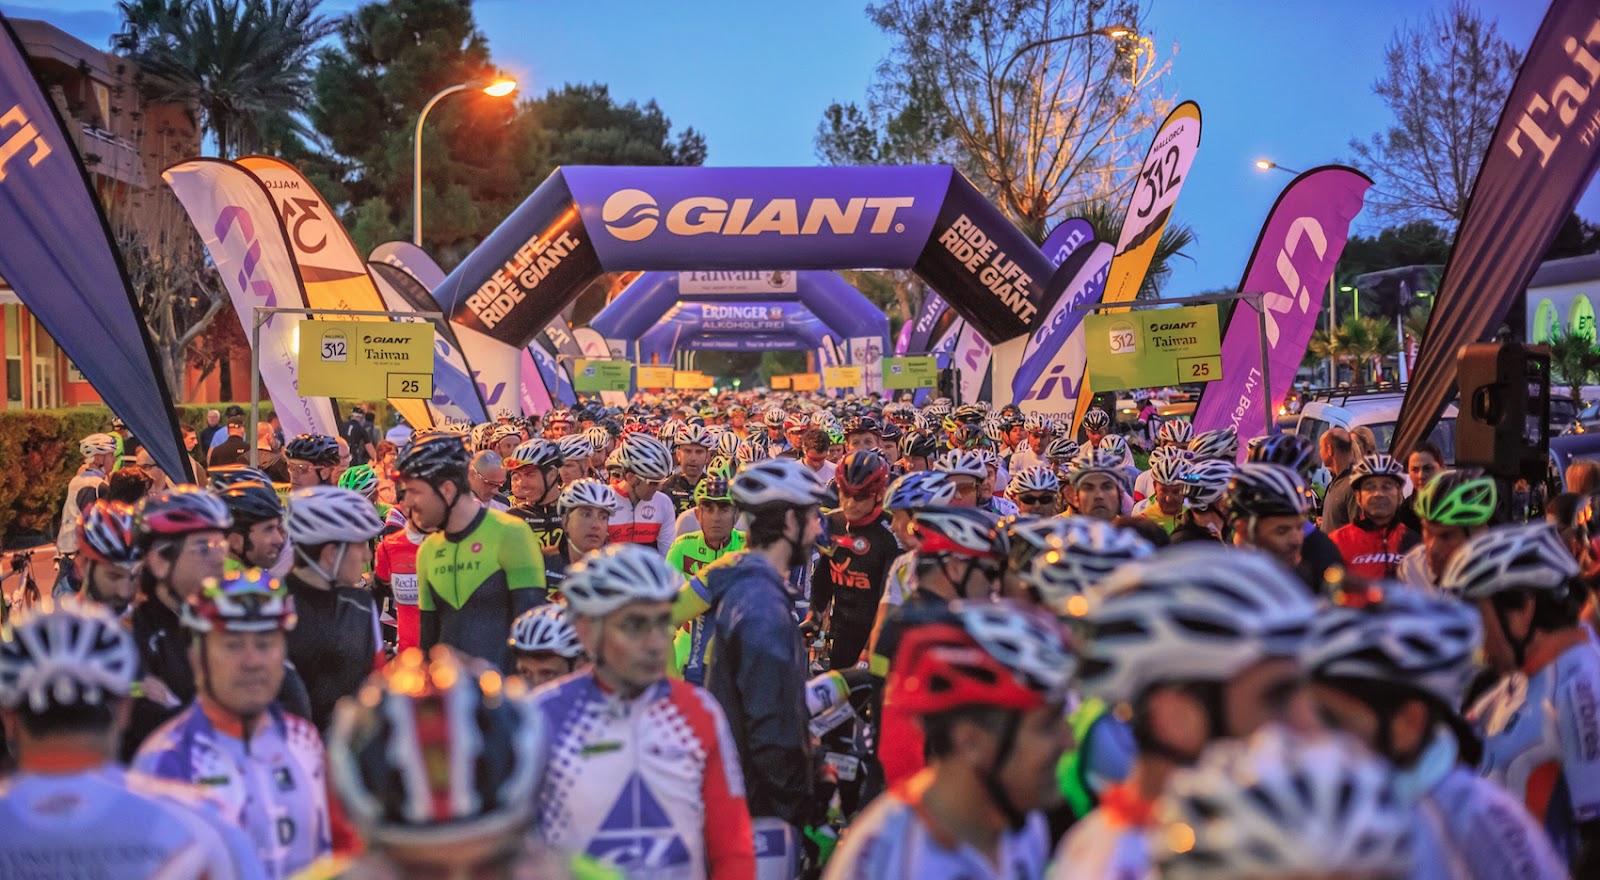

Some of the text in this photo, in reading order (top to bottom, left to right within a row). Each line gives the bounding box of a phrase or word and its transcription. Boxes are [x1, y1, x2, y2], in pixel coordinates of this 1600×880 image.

[1506, 18, 1600, 169] Tai
[1153, 125, 1184, 154] MALLORCA
[1137, 145, 1181, 218] 312
[665, 196, 914, 236] GIANT
[951, 213, 1033, 297] RIDE LIFE.
[465, 268, 510, 314] RIDE
[505, 235, 552, 277] LIFE.
[479, 231, 580, 329] RIDE GIANT.
[938, 228, 1038, 325] RIDE GIANT.
[1051, 260, 1110, 337] GIANT
[702, 305, 769, 320] ERDINGER
[703, 321, 784, 330] ALKOHOLFREI
[1160, 321, 1197, 331] GIANT
[321, 342, 346, 359] 312
[373, 337, 412, 345] GIANT
[1110, 333, 1135, 352] 312
[1152, 335, 1197, 347] Taiwan
[364, 348, 409, 361] Taiwan
[1192, 363, 1210, 377] 25
[401, 380, 419, 393] 25
[1245, 367, 1262, 394] Liv
[434, 561, 481, 576] FORMAT
